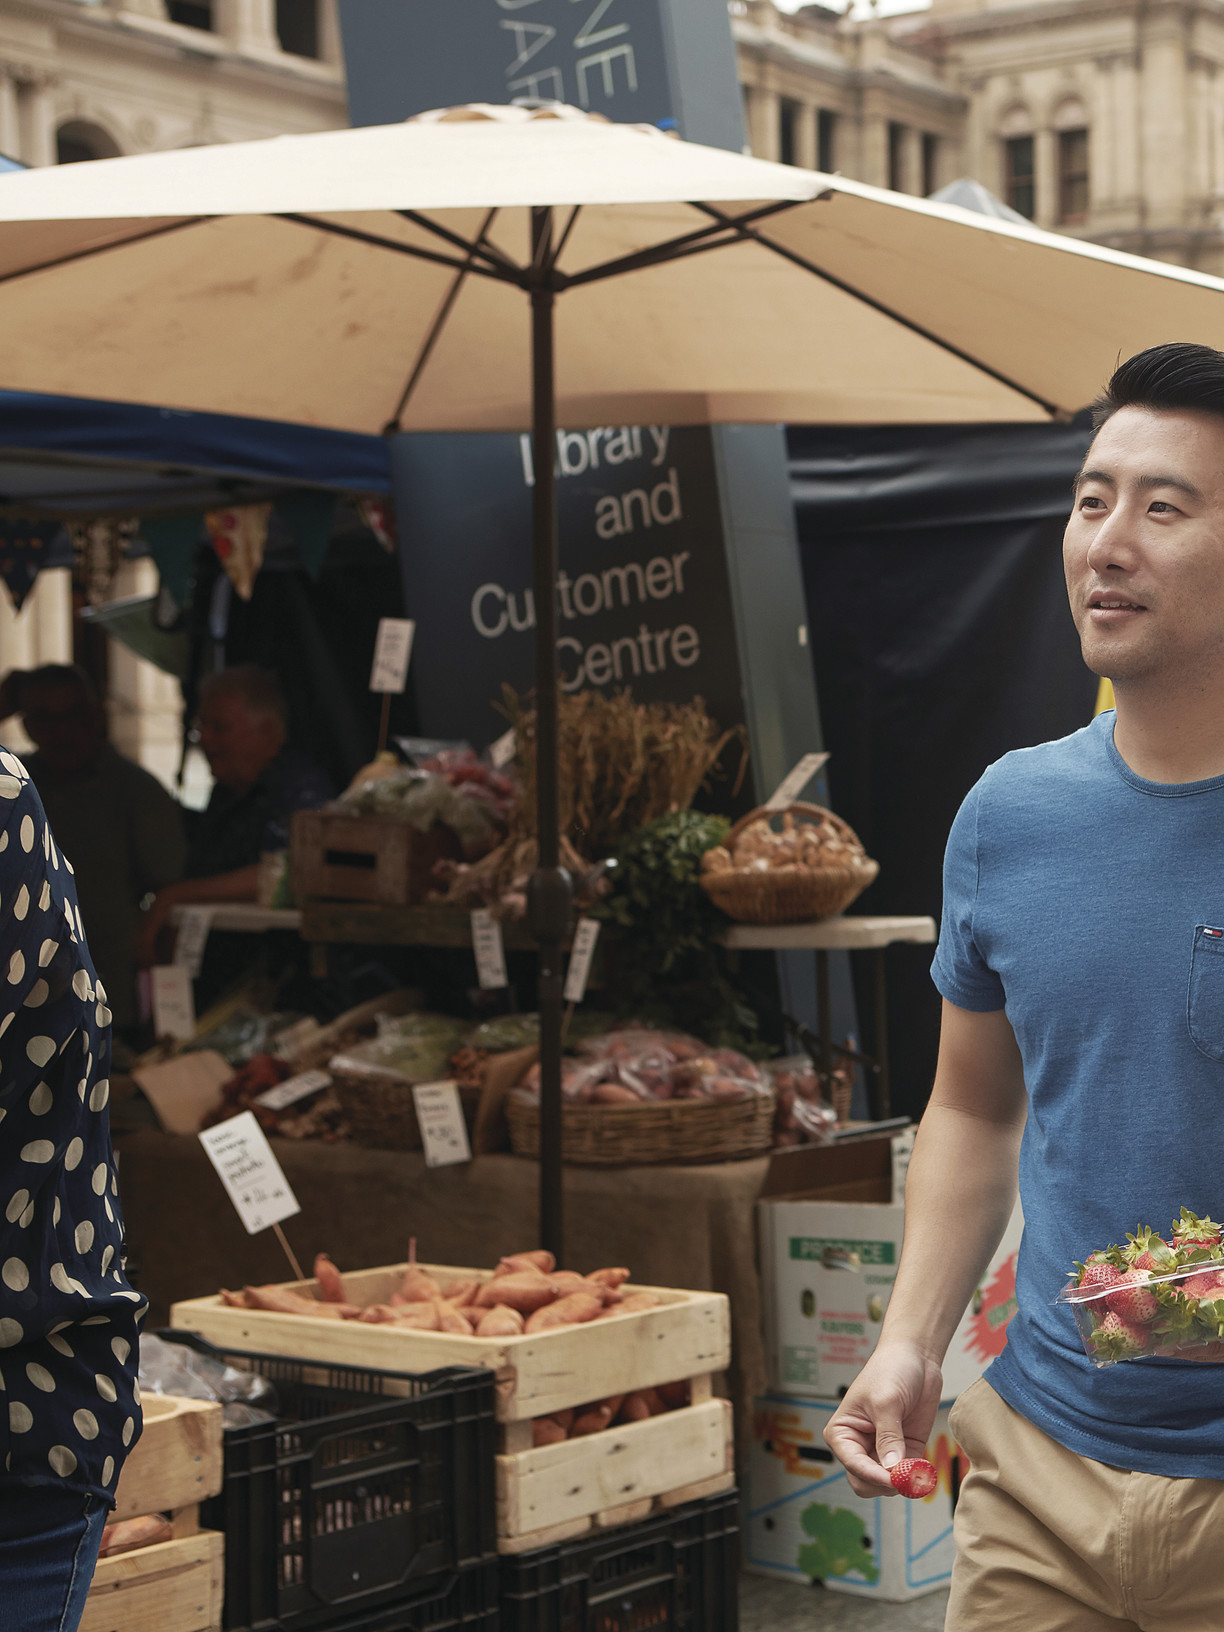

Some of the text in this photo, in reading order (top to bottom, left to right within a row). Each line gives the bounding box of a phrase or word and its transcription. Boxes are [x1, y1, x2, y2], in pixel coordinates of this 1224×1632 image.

[519, 424, 671, 487] Lbrary
[595, 466, 682, 539] and
[470, 551, 691, 639] Cutomer
